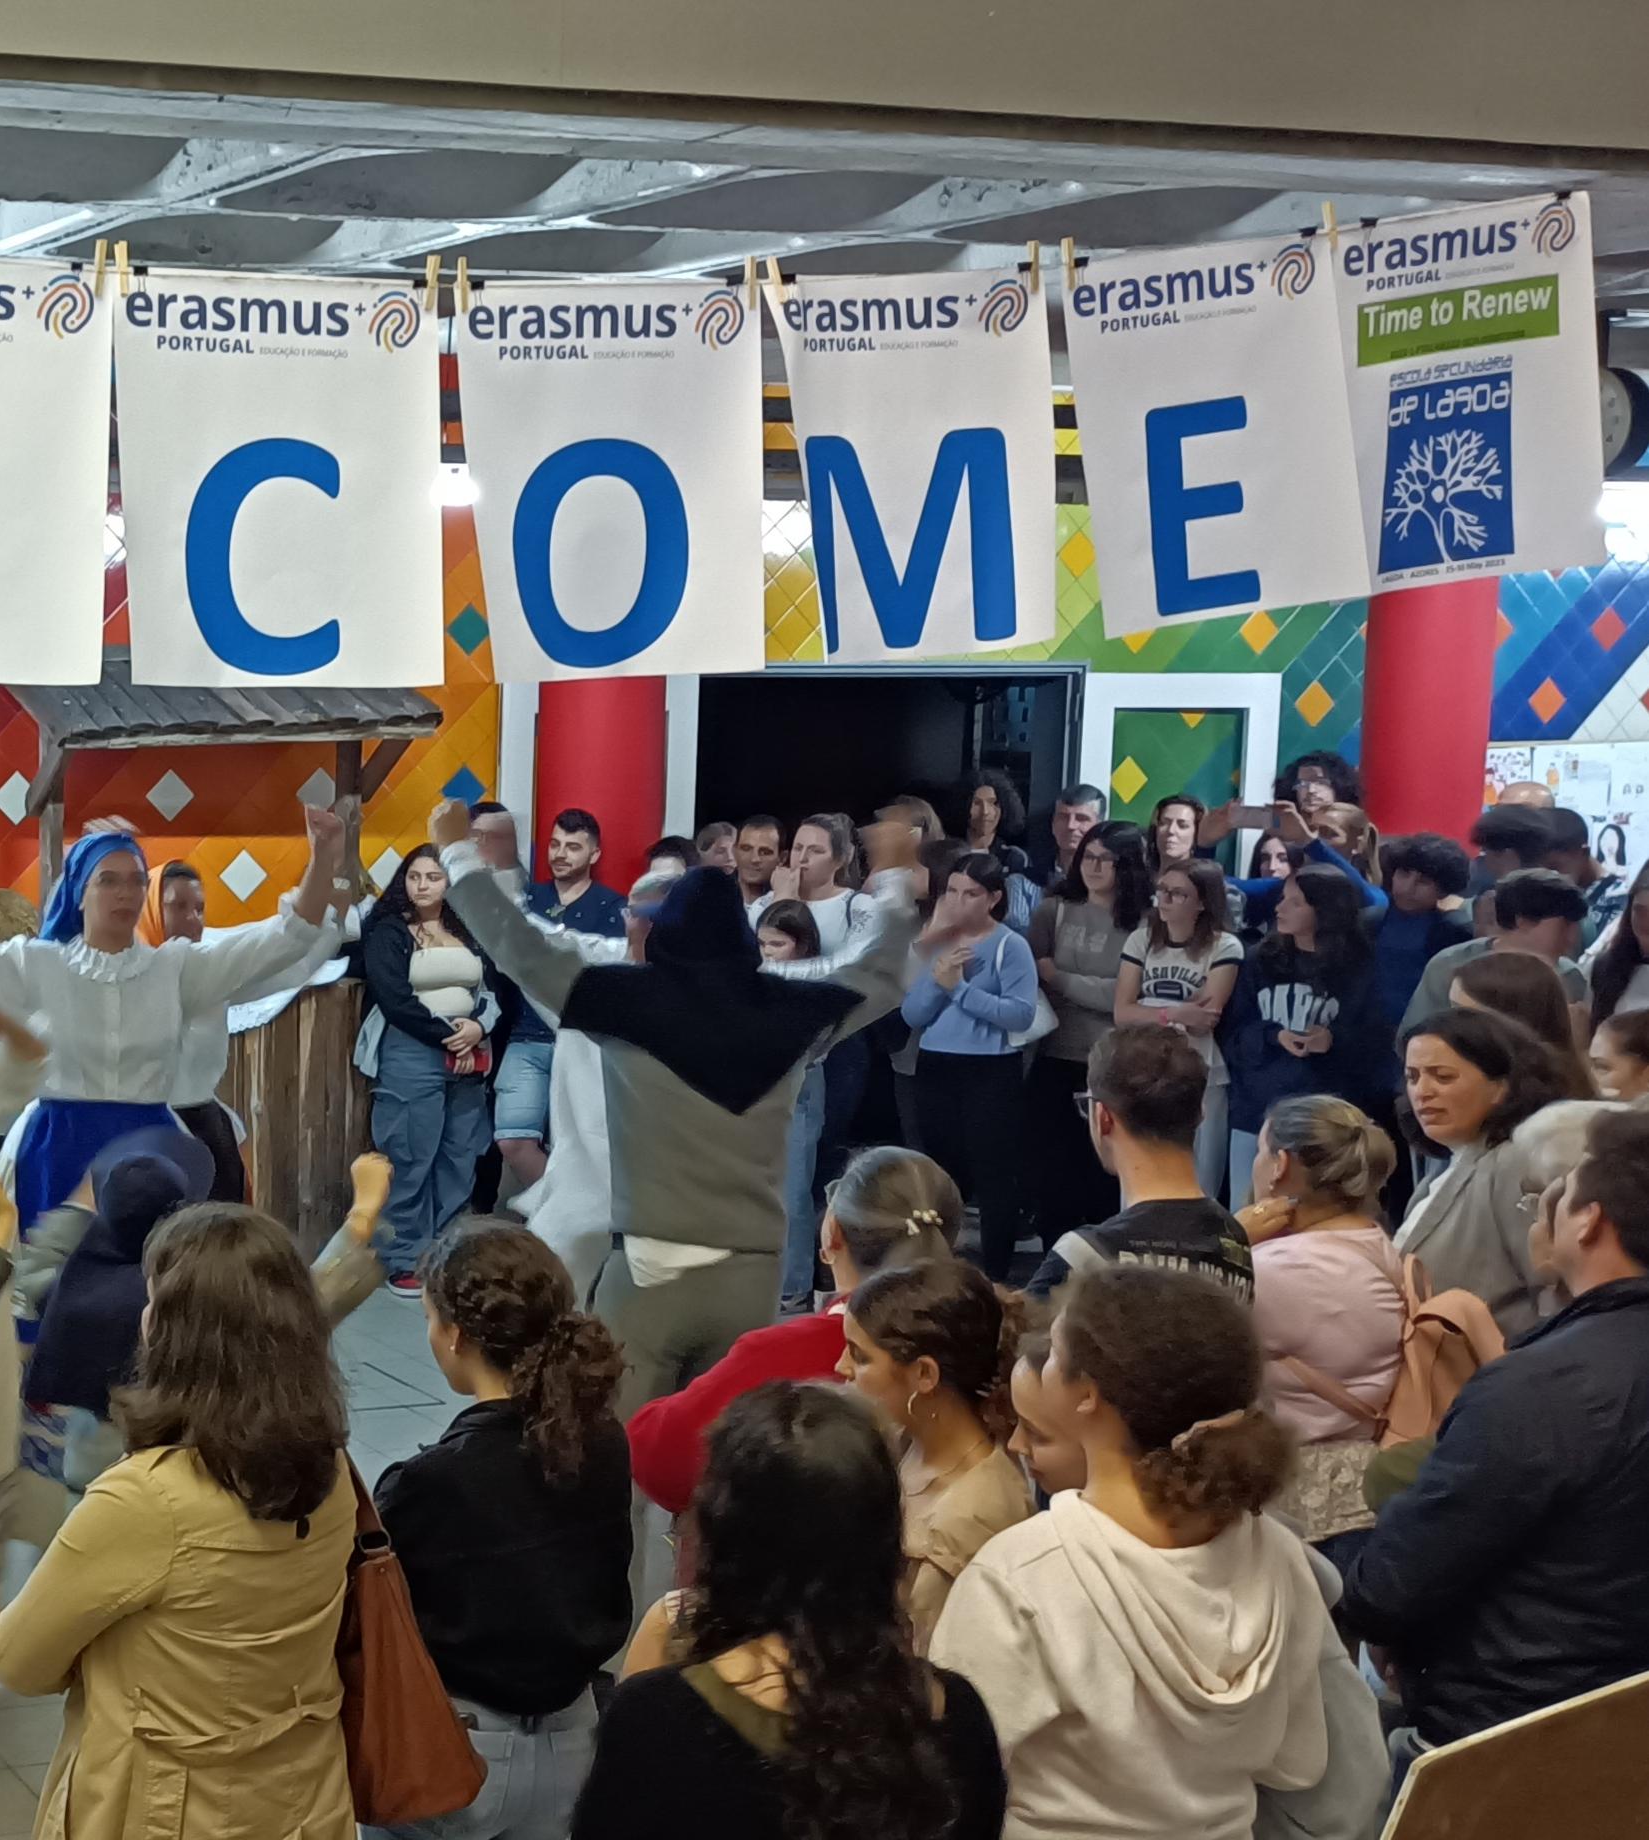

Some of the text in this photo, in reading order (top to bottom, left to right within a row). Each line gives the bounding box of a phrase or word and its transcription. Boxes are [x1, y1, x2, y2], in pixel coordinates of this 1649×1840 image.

[1367, 269, 1441, 292] PORTUGAL
[1101, 310, 1180, 334] PORTUGAL
[1363, 285, 1553, 338] Time to Renew
[157, 335, 254, 354] PORTUGAL
[499, 345, 588, 360] PORTUGAL
[186, 437, 342, 678] C
[513, 439, 690, 669] O
[806, 428, 1018, 653] M
[1146, 396, 1262, 616] E
